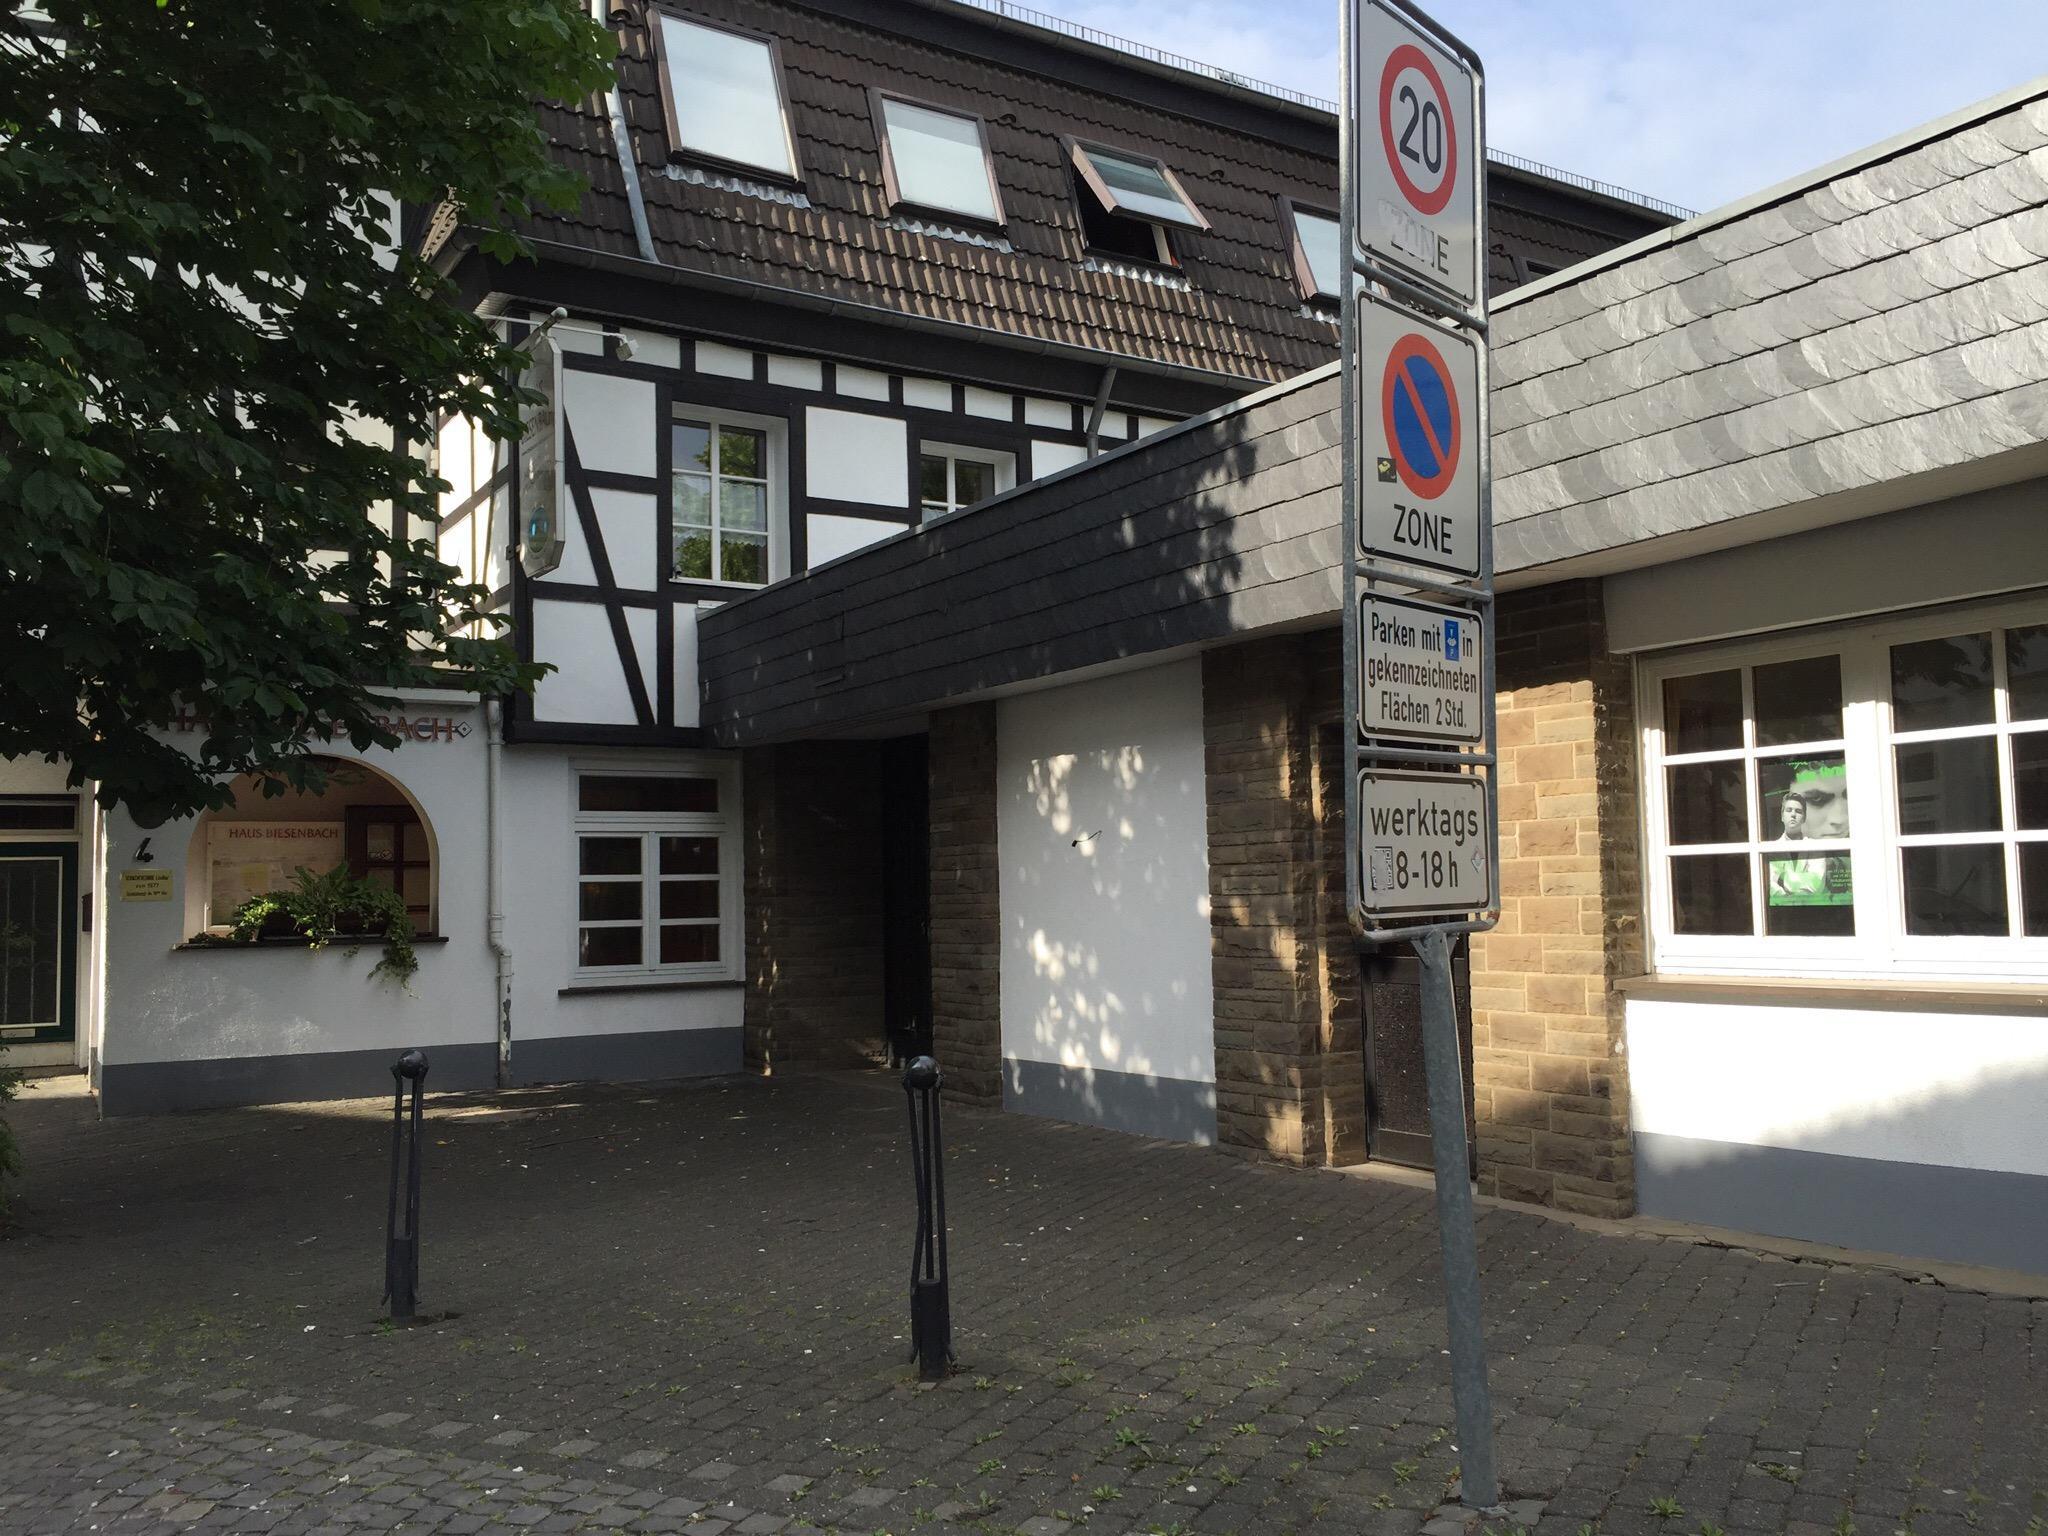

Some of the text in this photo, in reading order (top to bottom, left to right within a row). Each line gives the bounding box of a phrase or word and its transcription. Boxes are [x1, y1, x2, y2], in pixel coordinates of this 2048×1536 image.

[1399, 85, 1442, 174] 20
[1393, 503, 1453, 555] ZONE
[1371, 612, 1473, 657] Parken mit in
[1368, 653, 1477, 693] gekennzeichneten
[1381, 690, 1430, 724] Flächen
[229, 828, 339, 839] HAUS BIESENBACH
[1370, 798, 1479, 847] werktags
[135, 837, 154, 863] 4
[1396, 850, 1443, 889] 8-18
[1449, 850, 1459, 888] h
